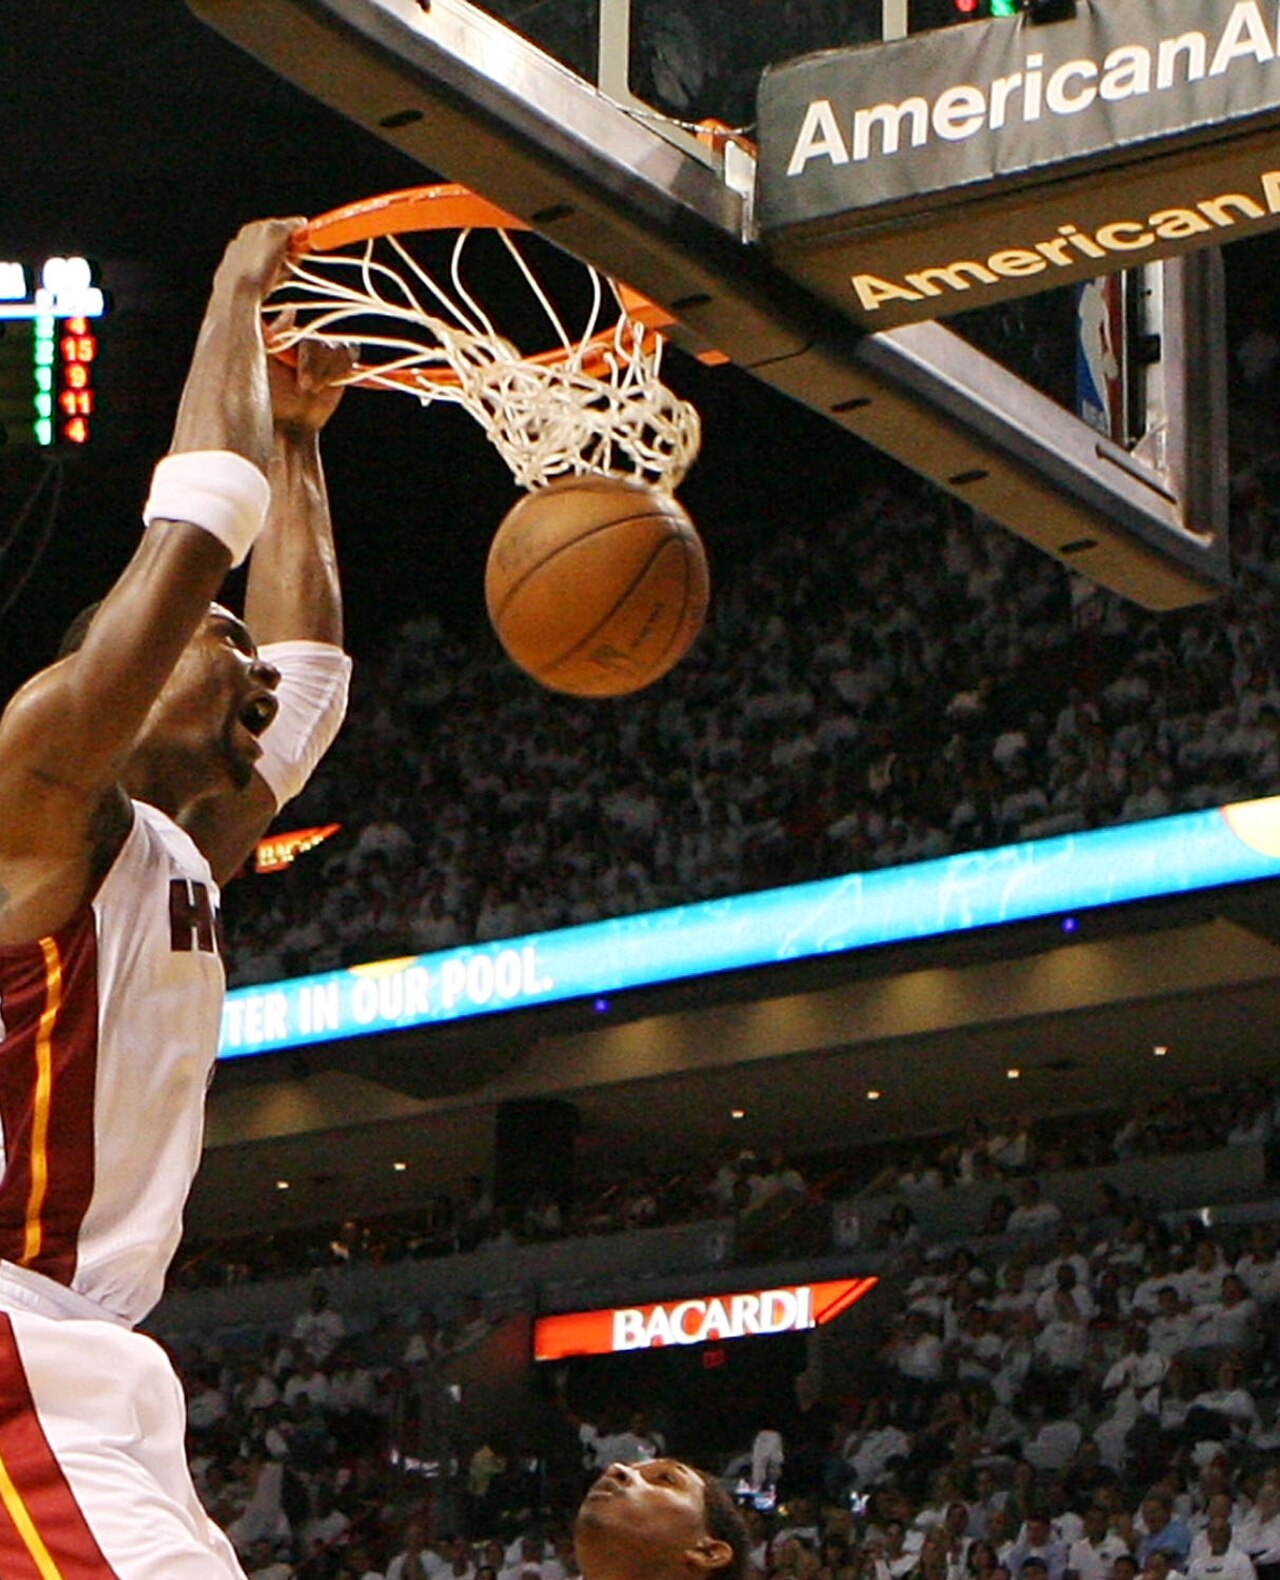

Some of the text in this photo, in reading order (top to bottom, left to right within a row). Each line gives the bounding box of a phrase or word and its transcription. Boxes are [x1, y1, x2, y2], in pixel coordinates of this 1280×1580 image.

[787, 0, 1280, 177] AmericanA
[169, 879, 217, 952] H
[223, 948, 554, 1046] TER IN OUR POOL.
